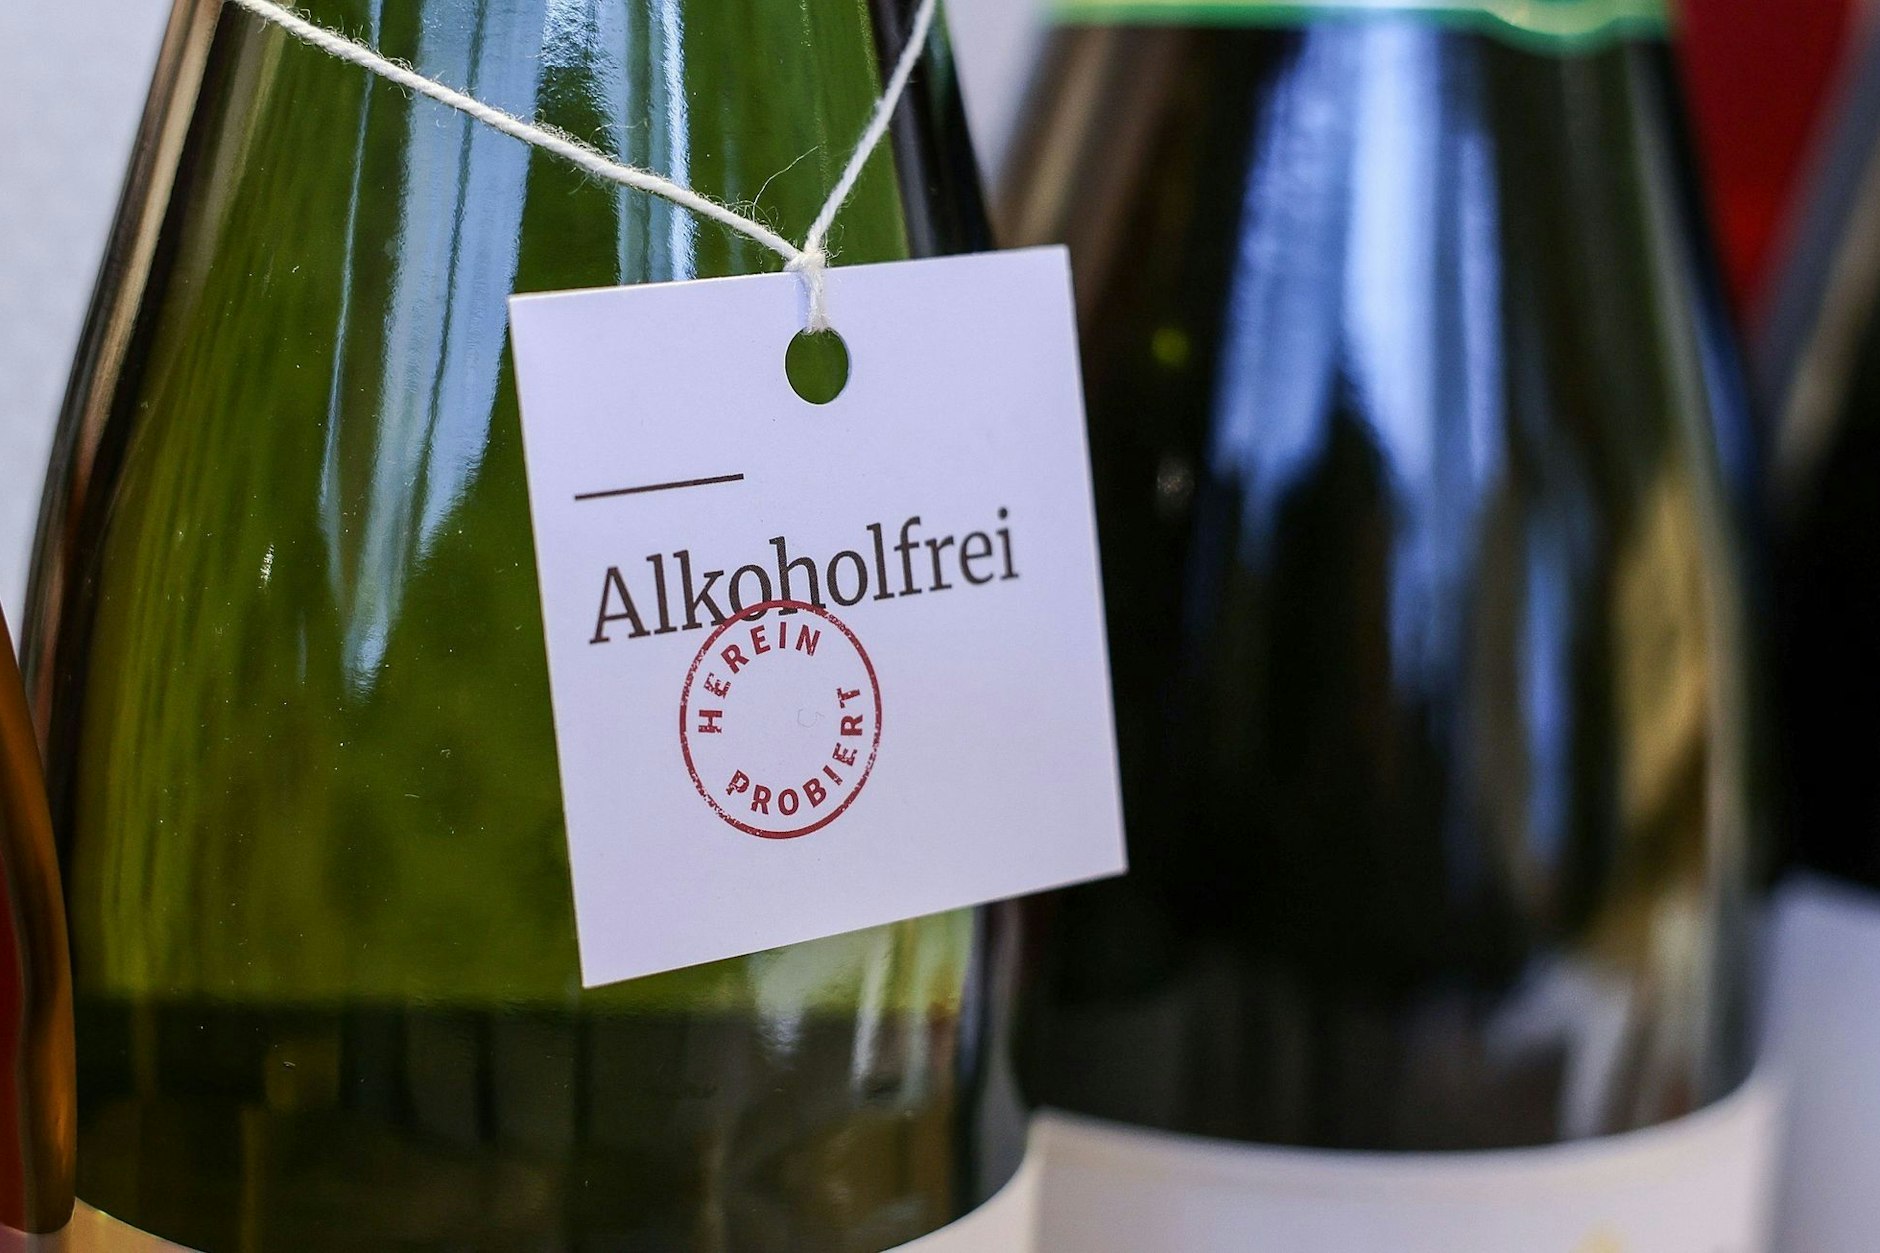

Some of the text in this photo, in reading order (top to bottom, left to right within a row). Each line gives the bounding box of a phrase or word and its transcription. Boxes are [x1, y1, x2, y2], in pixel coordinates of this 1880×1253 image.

[589, 507, 1019, 644] Alkoholfrei
[698, 621, 821, 734] HEREIN
[726, 687, 862, 816] PROBIERT
